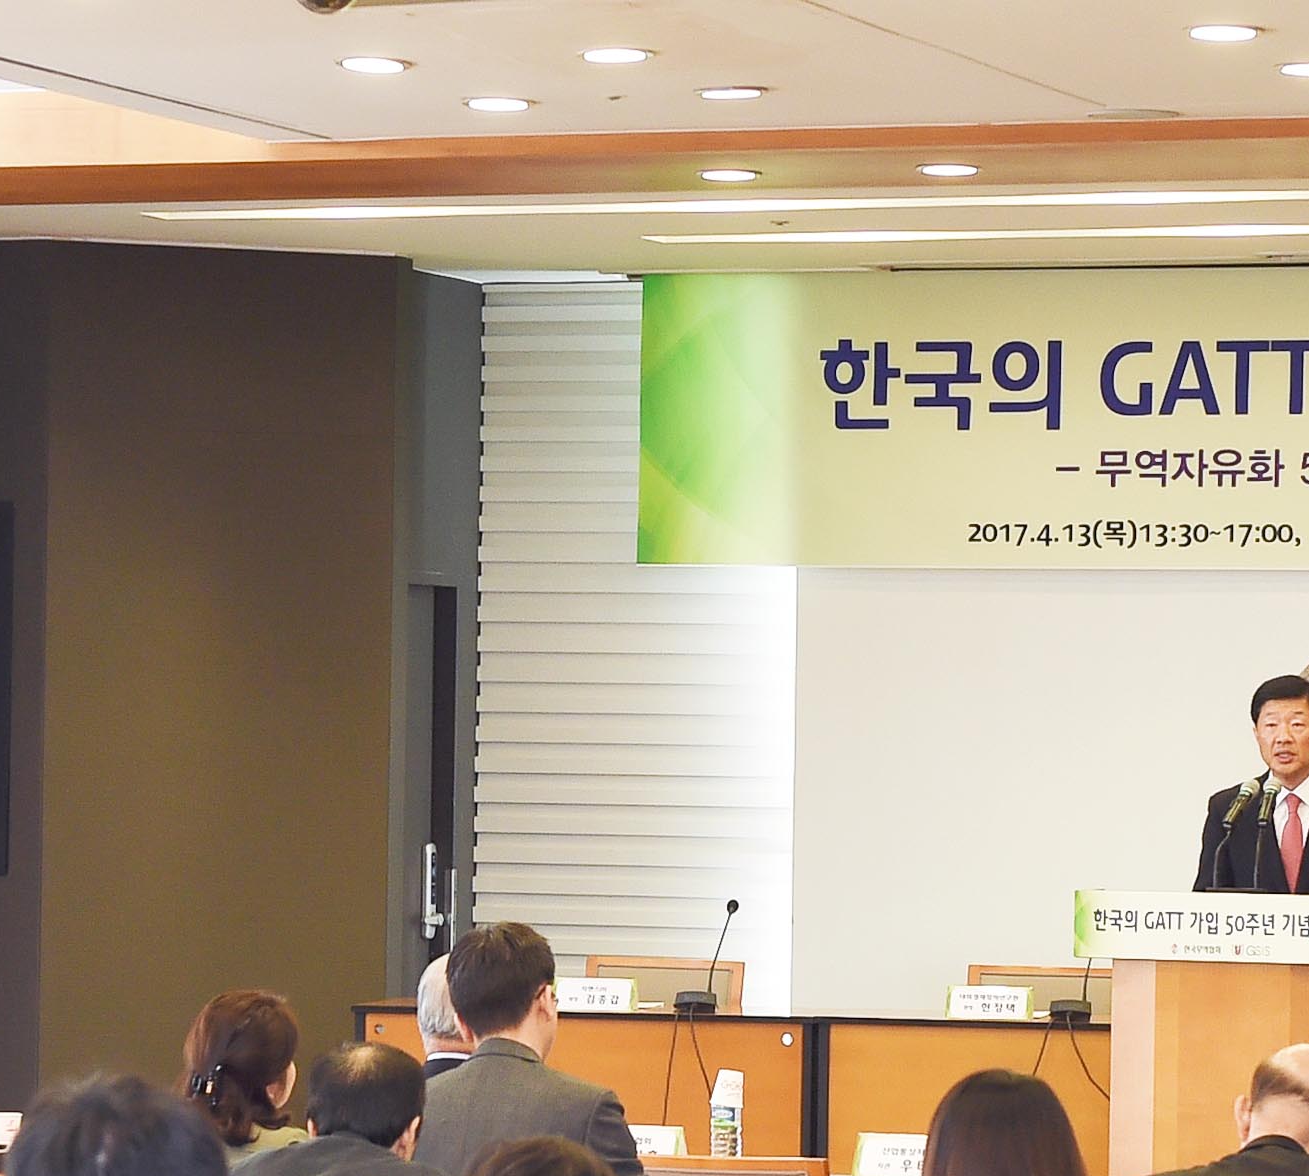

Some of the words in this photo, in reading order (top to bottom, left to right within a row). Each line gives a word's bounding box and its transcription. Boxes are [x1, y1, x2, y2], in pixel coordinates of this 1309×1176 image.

[818, 338, 1064, 432] 한국의
[1095, 448, 1286, 488] 무역자유화
[1093, 908, 1138, 933] 한국의
[1144, 911, 1184, 930] GATT
[1189, 912, 1219, 935] 가입
[1225, 913, 1275, 936] 50주년
